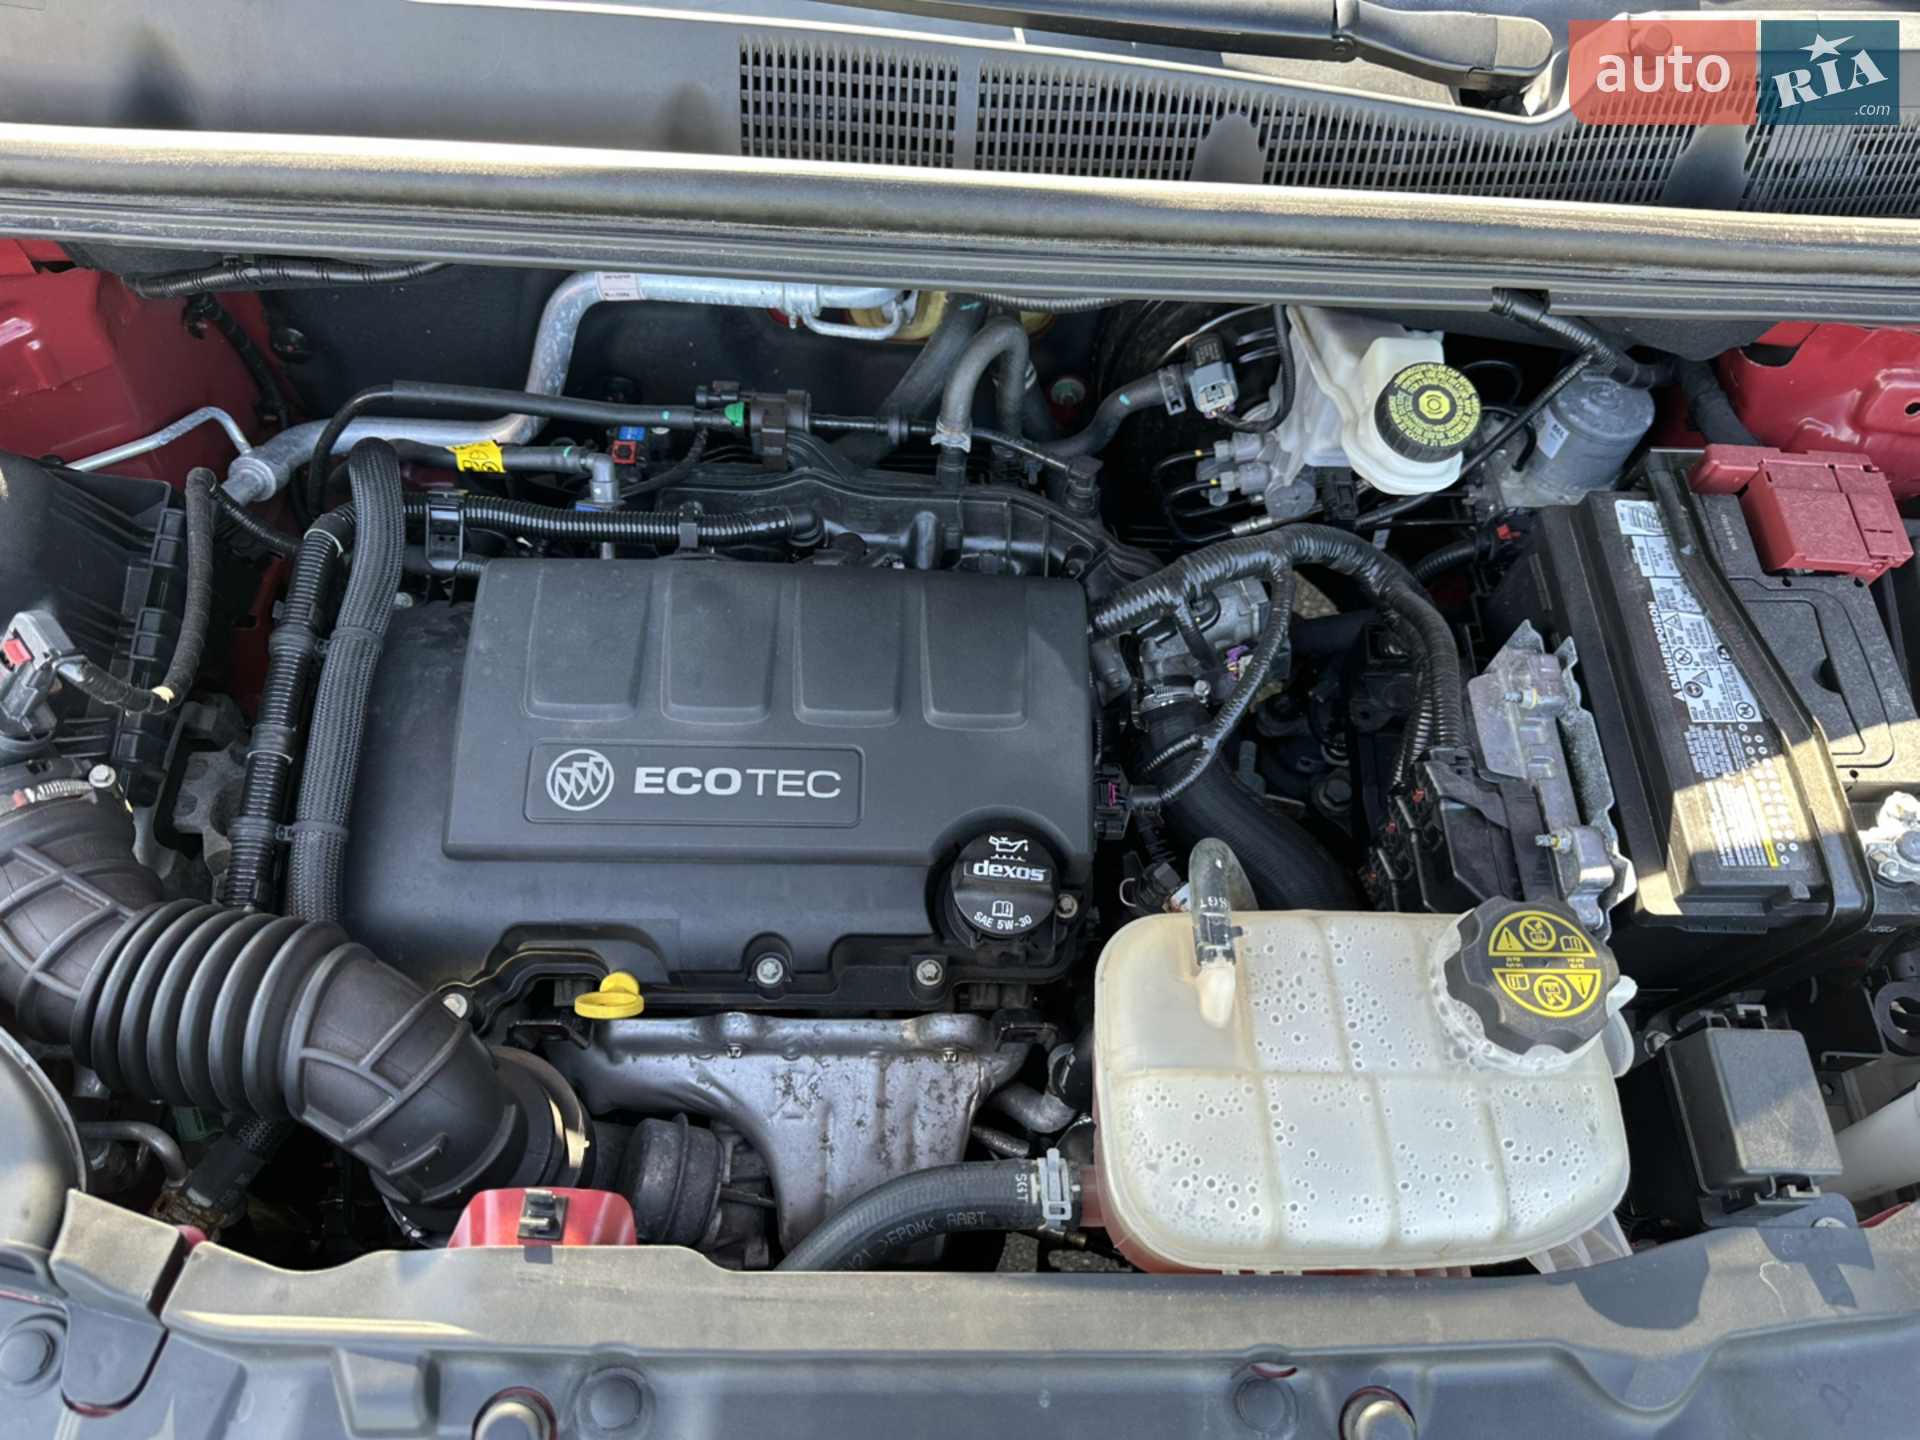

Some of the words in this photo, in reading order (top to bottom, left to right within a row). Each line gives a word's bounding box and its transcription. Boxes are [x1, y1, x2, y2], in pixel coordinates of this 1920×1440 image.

[633, 766, 842, 799] ECOTEC
[973, 860, 1047, 882] dexos
[974, 911, 994, 928] SAE
[996, 914, 1033, 930] 5W-30
